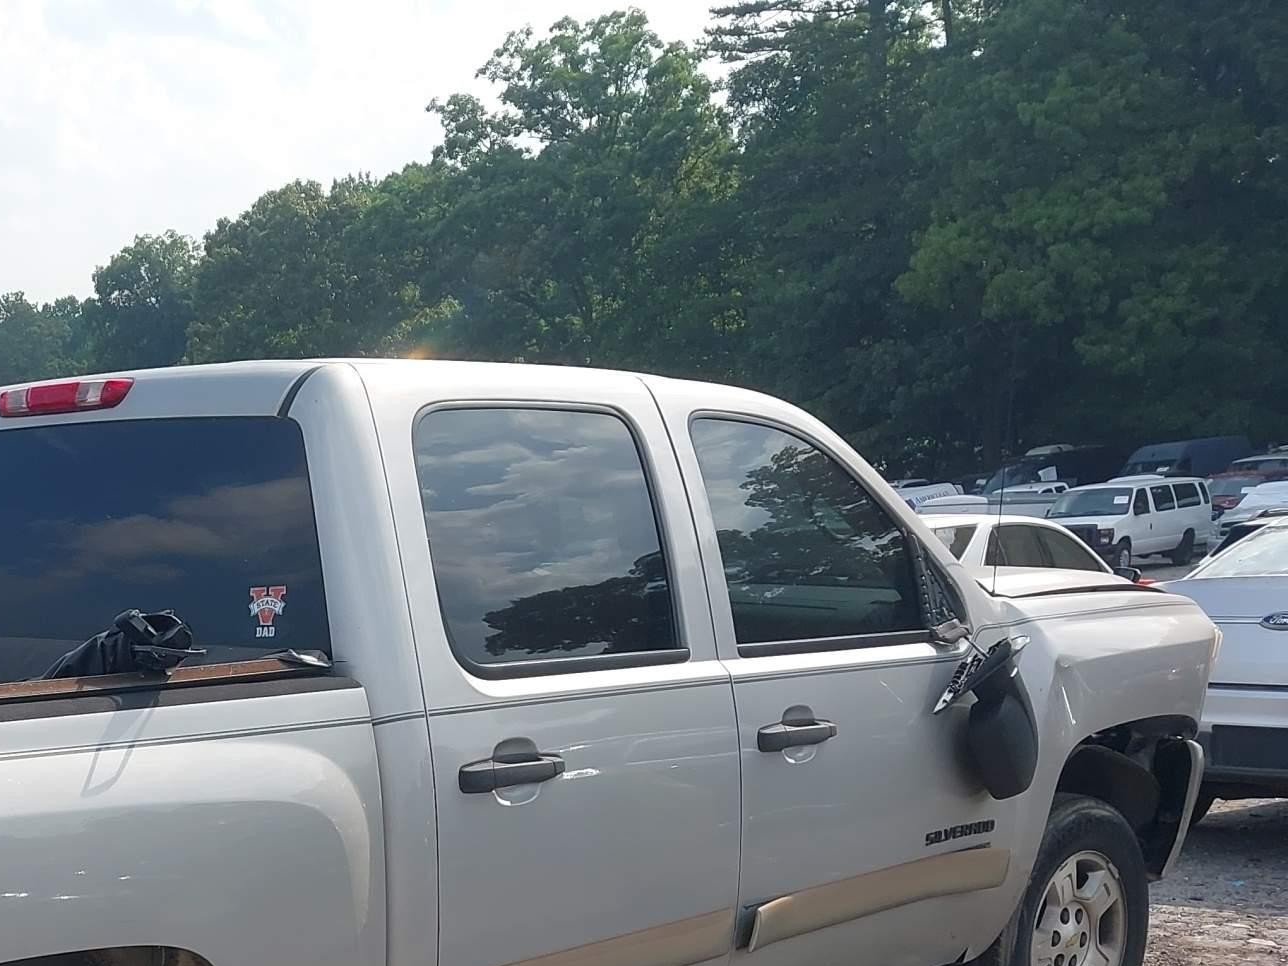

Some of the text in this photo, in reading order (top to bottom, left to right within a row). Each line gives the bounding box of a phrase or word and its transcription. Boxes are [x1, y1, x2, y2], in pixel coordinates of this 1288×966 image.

[256, 599, 280, 609] STATE
[255, 626, 276, 638] DAD
[924, 819, 996, 847] SILVERADO
